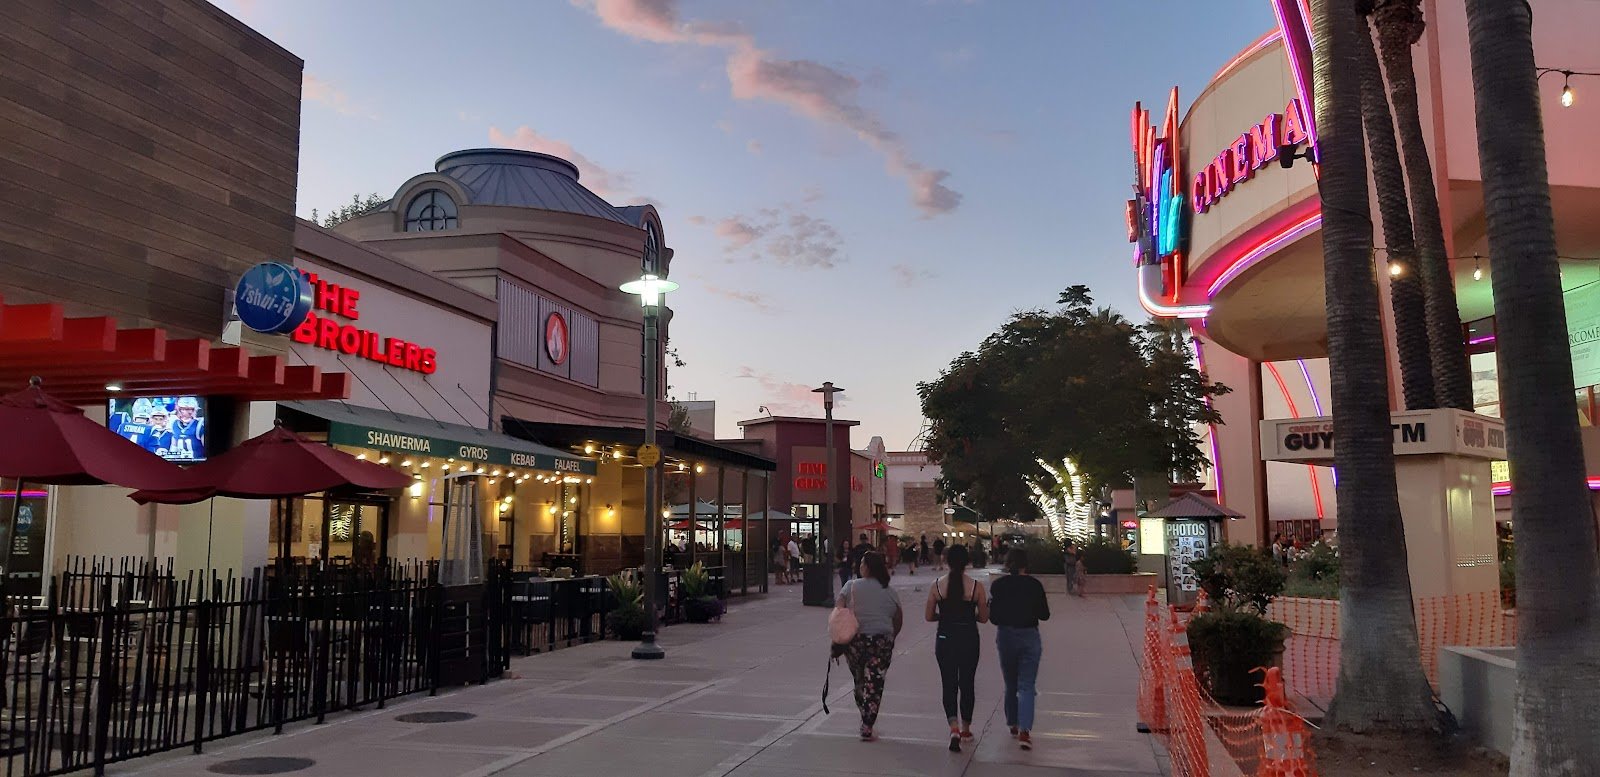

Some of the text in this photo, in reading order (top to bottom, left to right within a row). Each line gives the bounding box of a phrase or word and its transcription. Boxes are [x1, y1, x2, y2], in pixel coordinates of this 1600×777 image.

[299, 269, 359, 320] THE
[292, 311, 436, 373] BROILERS
[367, 430, 580, 472] SHAWERMA GYROS KEBAB FALAFEL
[1166, 523, 1205, 536] PHOTOS
